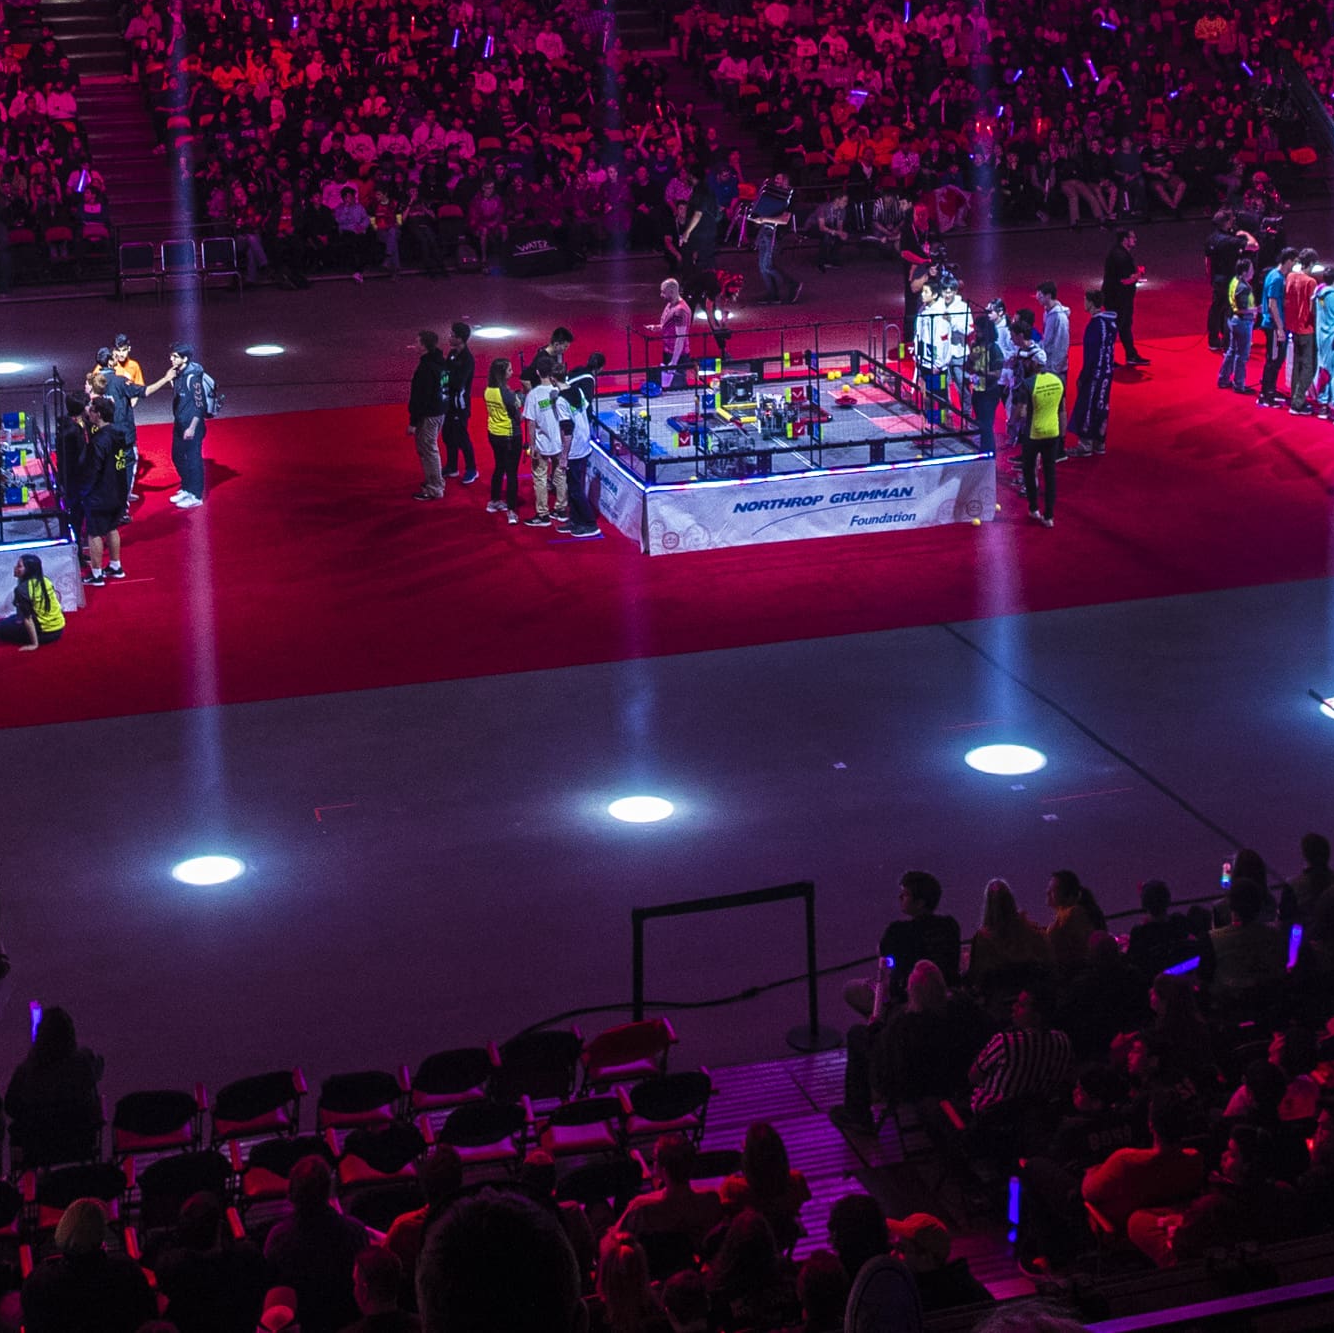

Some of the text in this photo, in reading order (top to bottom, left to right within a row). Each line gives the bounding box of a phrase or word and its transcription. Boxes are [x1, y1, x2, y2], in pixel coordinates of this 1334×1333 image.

[733, 486, 915, 513] NORTHROP GRUMMAN
[850, 511, 916, 527] Foundation
